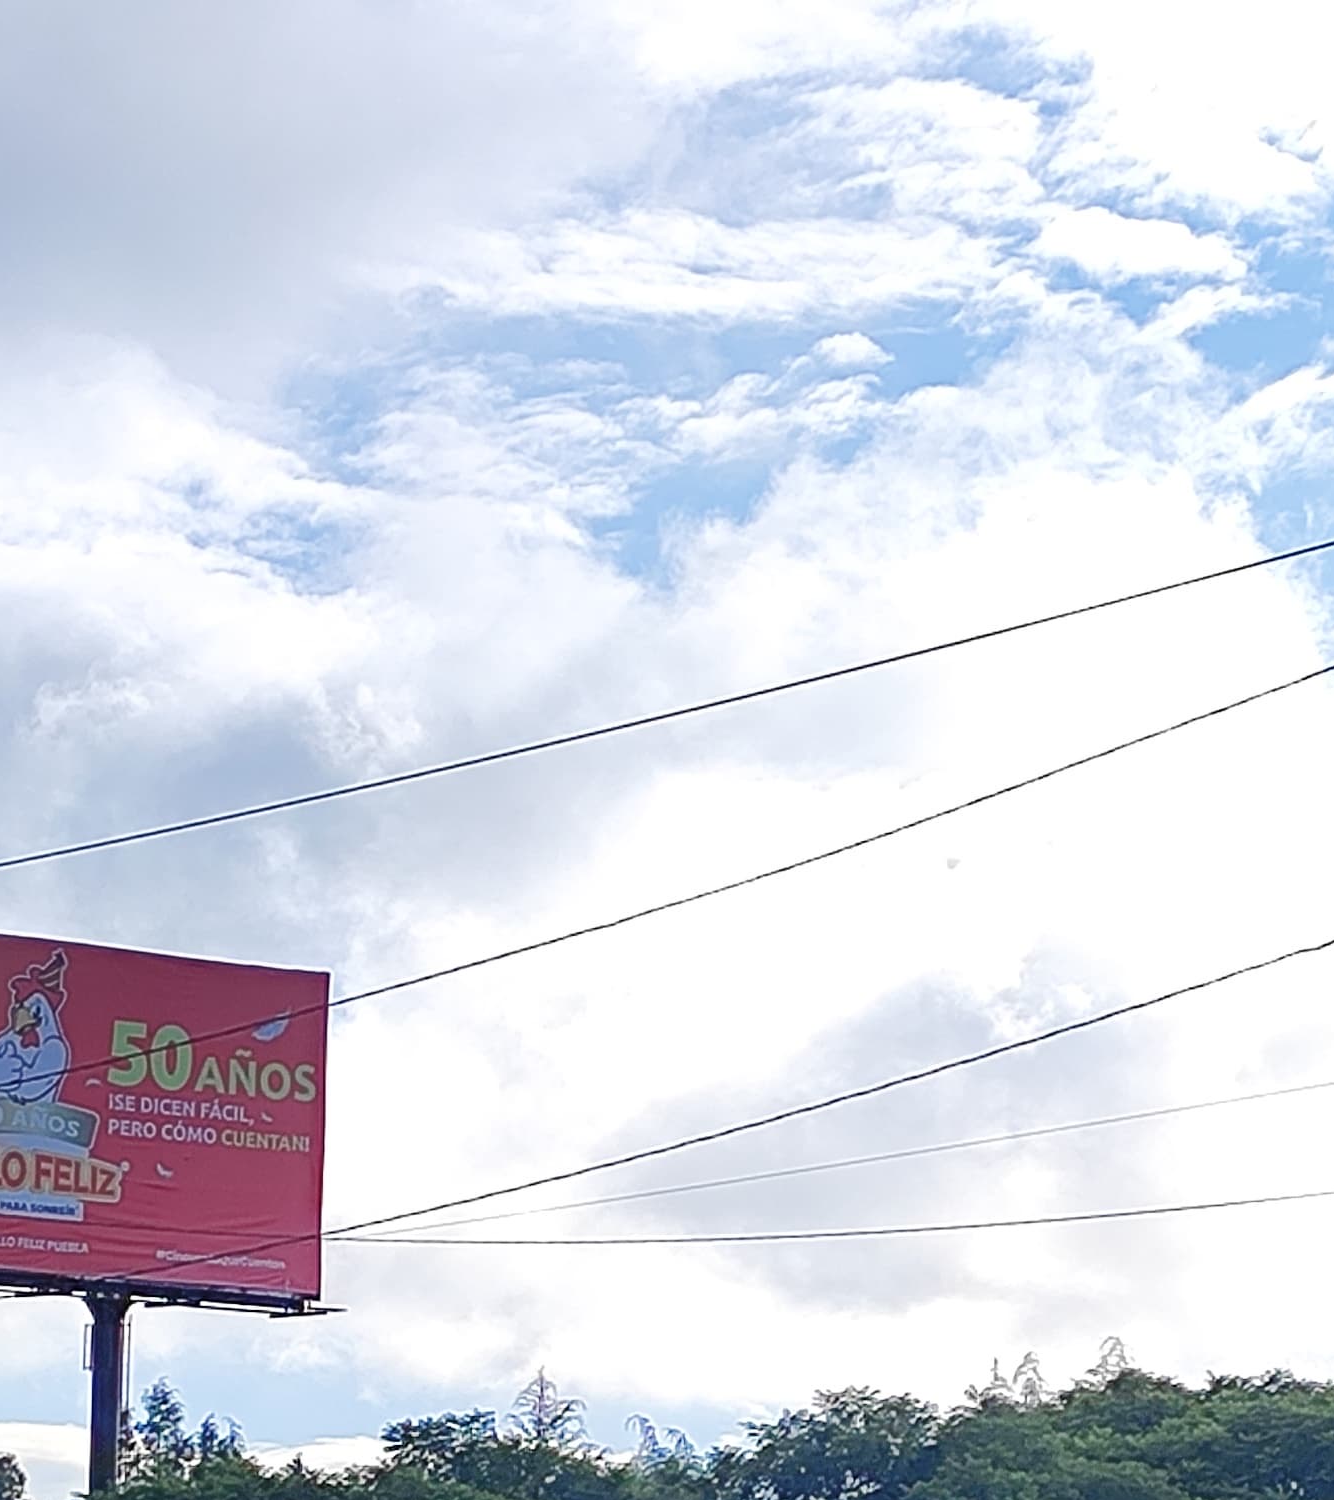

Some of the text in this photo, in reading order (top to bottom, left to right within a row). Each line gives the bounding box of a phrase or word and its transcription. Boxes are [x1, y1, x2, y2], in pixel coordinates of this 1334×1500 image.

[107, 1020, 316, 1101] 50 AÑOS
[11, 1101, 81, 1138] AÑOS
[140, 1096, 196, 1118] DICEN
[200, 1099, 254, 1126] FÁCIL,
[107, 1118, 311, 1152] PERO CÓMO CUENTAN!
[34, 1153, 116, 1197] FELIZ
[0, 1200, 28, 1213] PARA
[17, 1237, 46, 1250] FELIZ
[47, 1240, 89, 1253] PUEBLA
